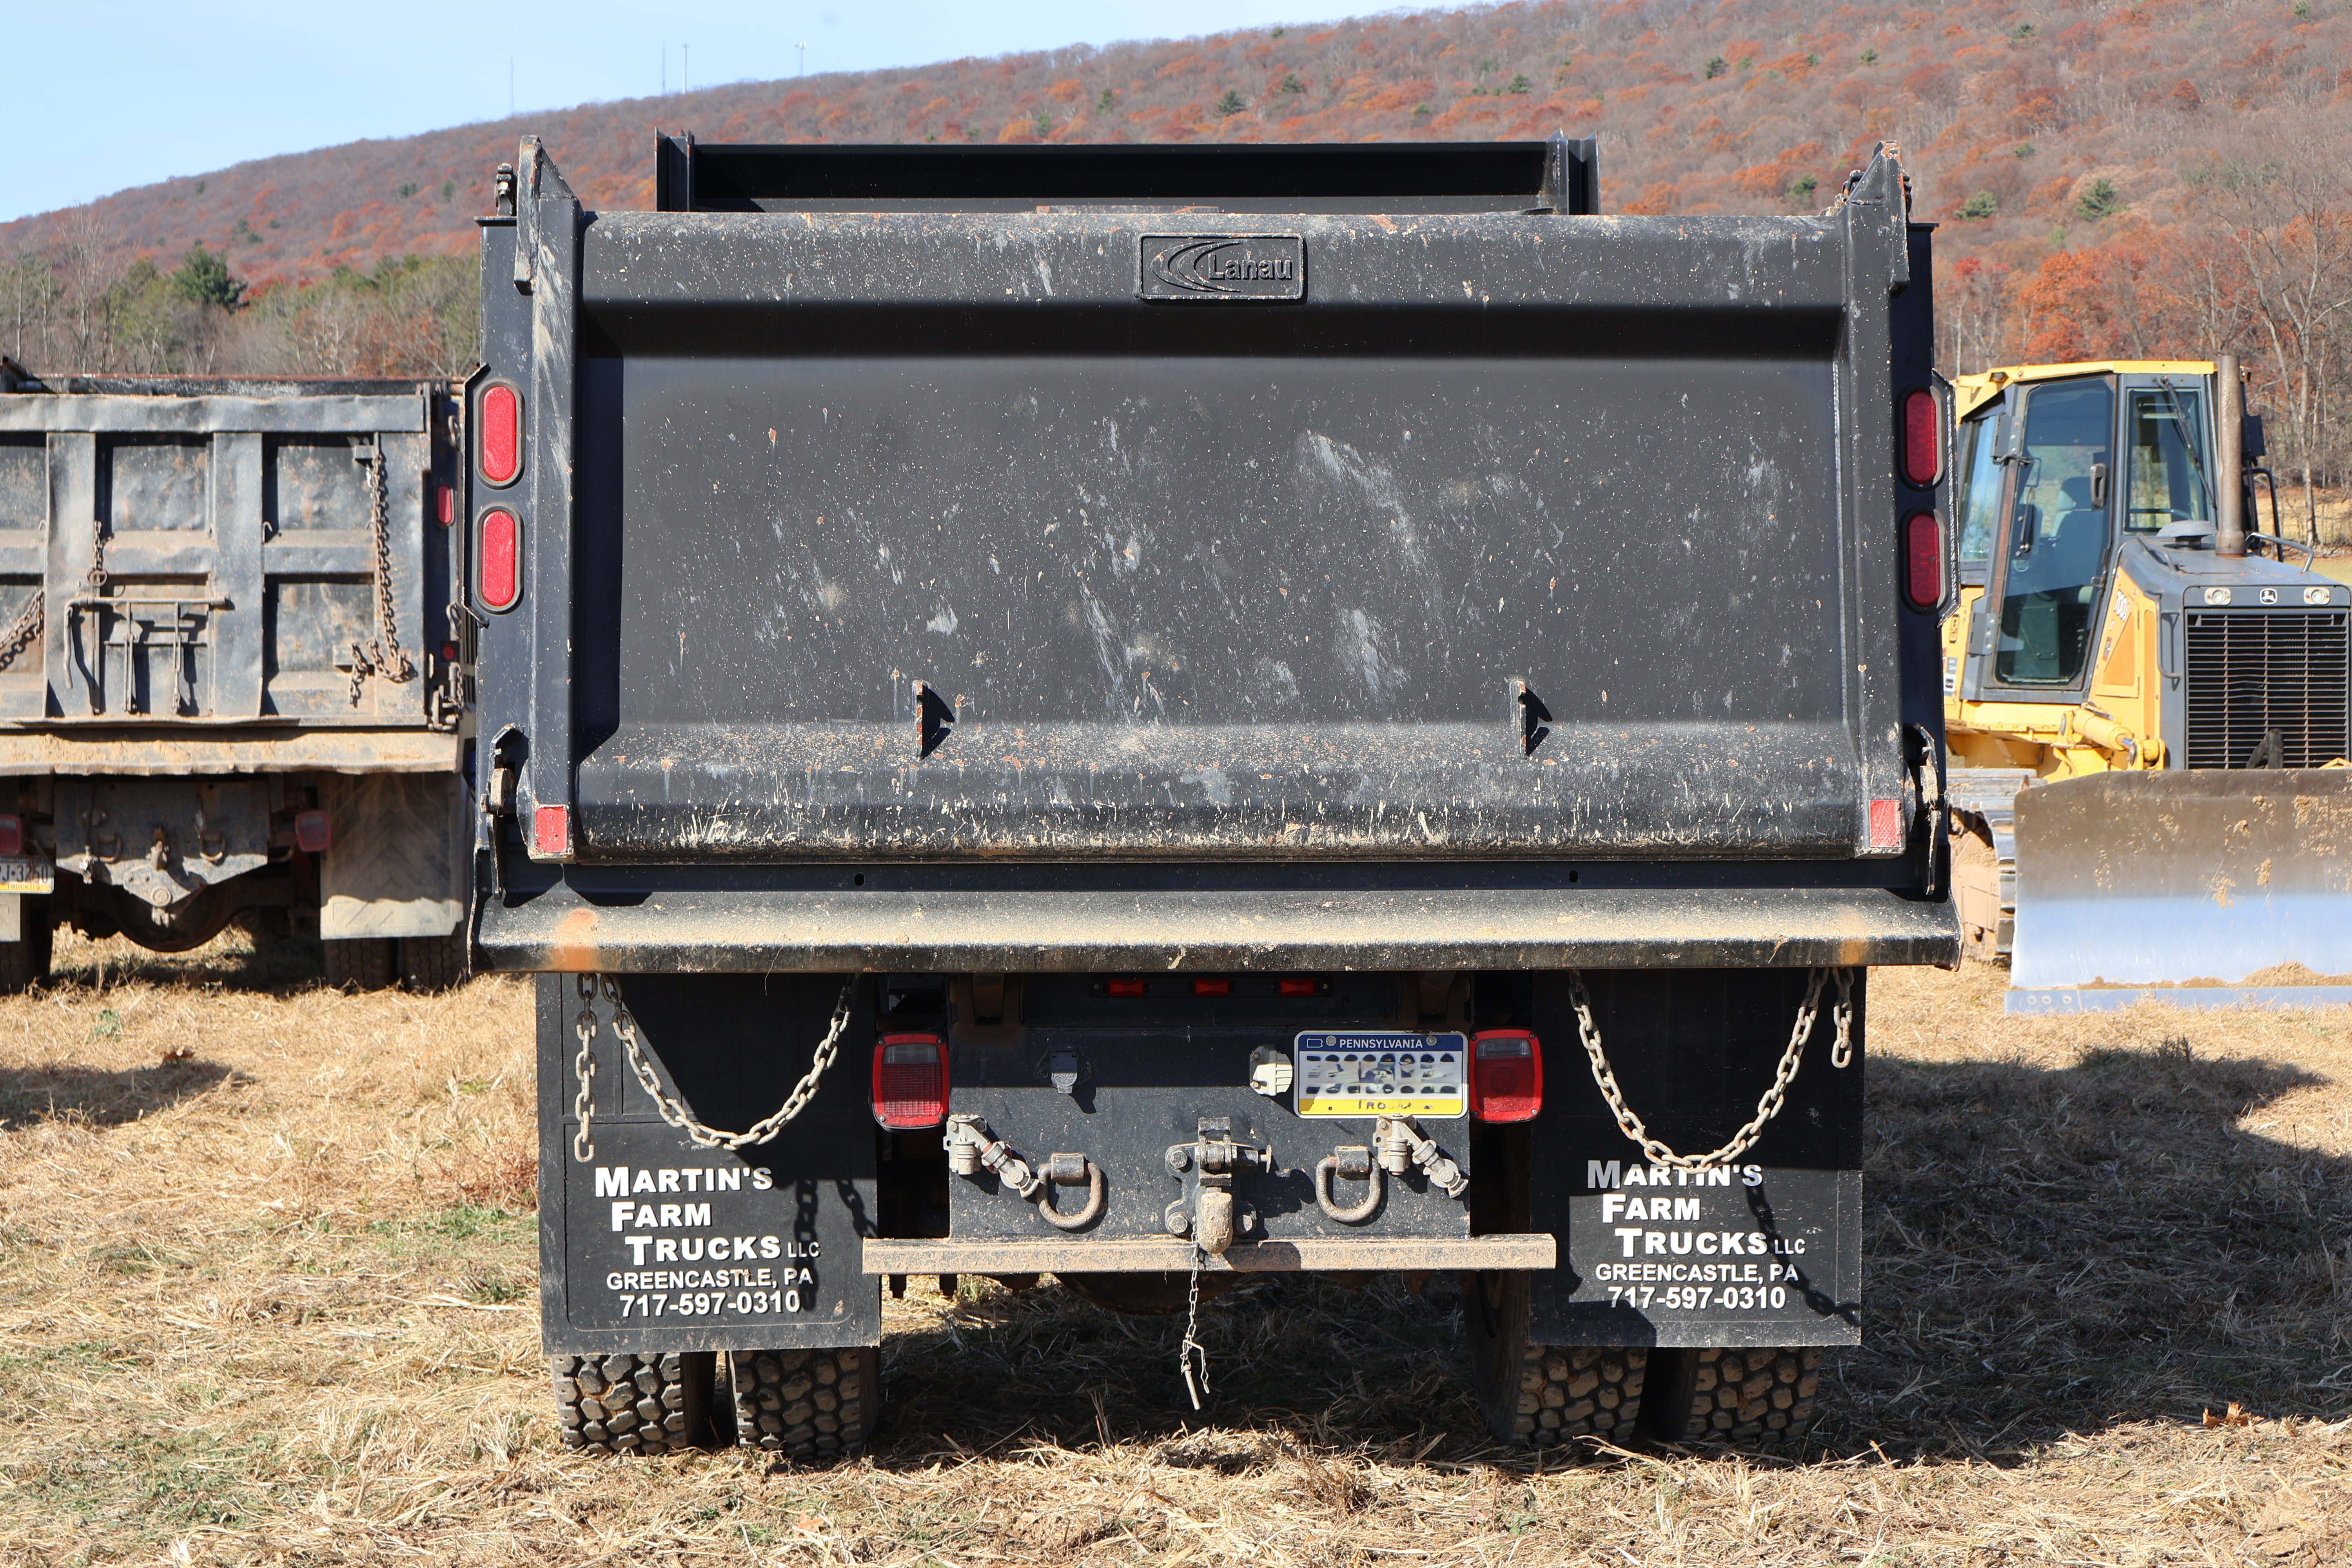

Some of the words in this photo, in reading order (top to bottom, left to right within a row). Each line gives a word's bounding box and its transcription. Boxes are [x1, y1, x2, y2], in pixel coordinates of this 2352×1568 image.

[1208, 252, 1292, 280] Lanau
[1339, 1039, 1423, 1049] PENNSYLVANIA
[595, 1167, 773, 1197] MARTIN'S
[1588, 1160, 1763, 1189] MARTIN'S
[612, 1201, 711, 1232] FARM
[1602, 1194, 1700, 1223] FARM
[624, 1236, 781, 1266] TRUCKS
[788, 1241, 820, 1258] LLC
[1614, 1228, 1768, 1257] TRUCKS
[1774, 1238, 1806, 1254] LLC
[606, 1269, 777, 1290] GREENCASTLE,
[784, 1267, 813, 1285] PA
[1595, 1263, 1763, 1284] GREENCASTLE,
[1770, 1263, 1798, 1281] PA
[620, 1290, 800, 1317] 717-597-0310
[1608, 1286, 1786, 1310] 717-597-0310
